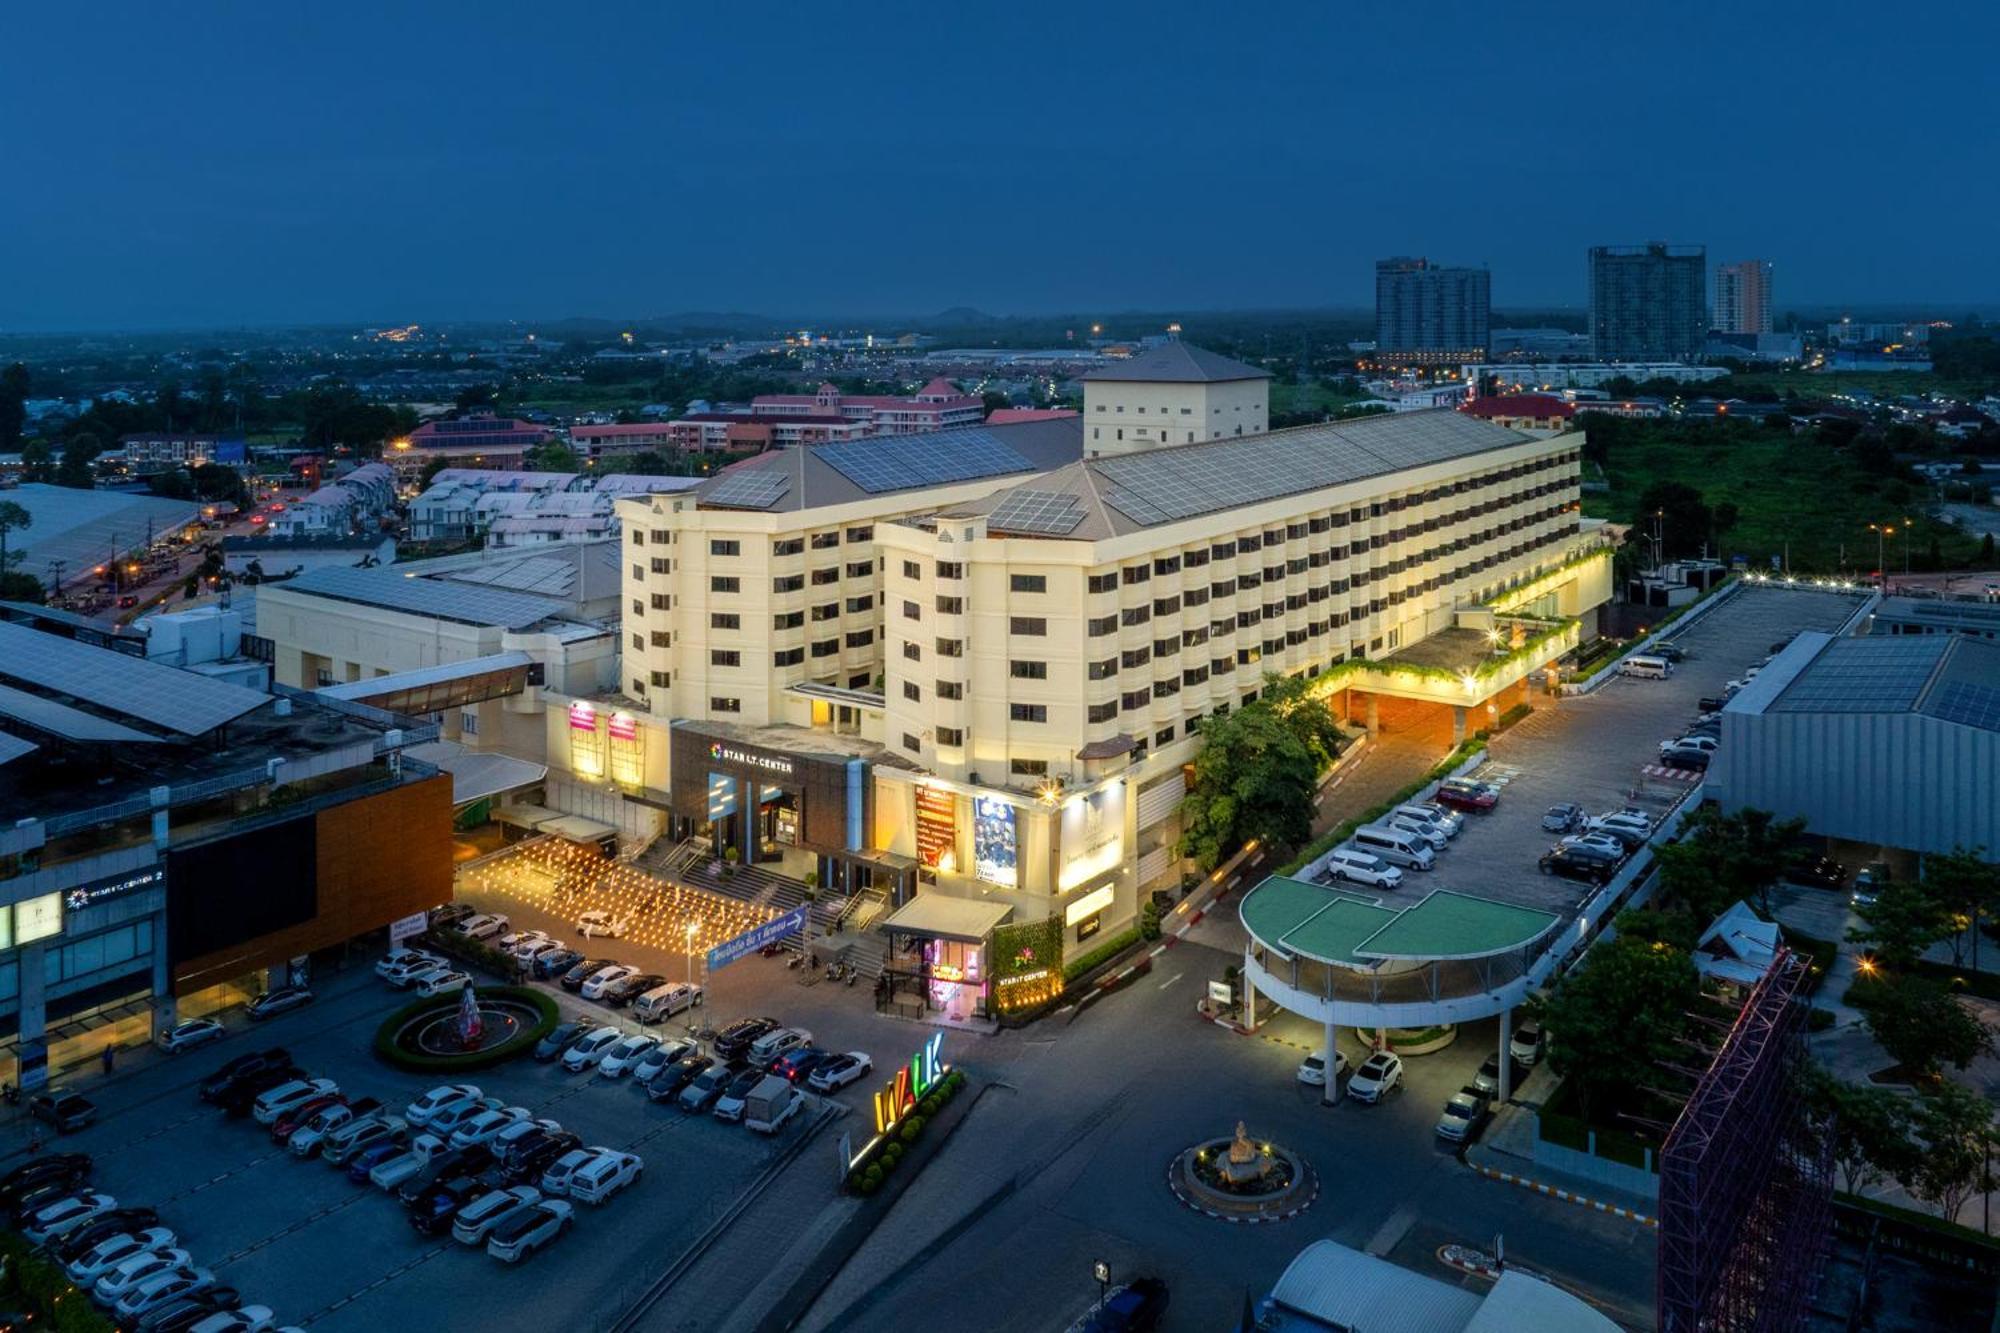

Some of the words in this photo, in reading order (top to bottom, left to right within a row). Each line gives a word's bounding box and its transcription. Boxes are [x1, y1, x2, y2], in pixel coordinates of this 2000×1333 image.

[723, 749, 745, 763] STAR
[759, 757, 792, 773] CENTER
[156, 871, 162, 880] 2
[1023, 970, 1048, 982] CENTER
[873, 1029, 944, 1136] WALK
